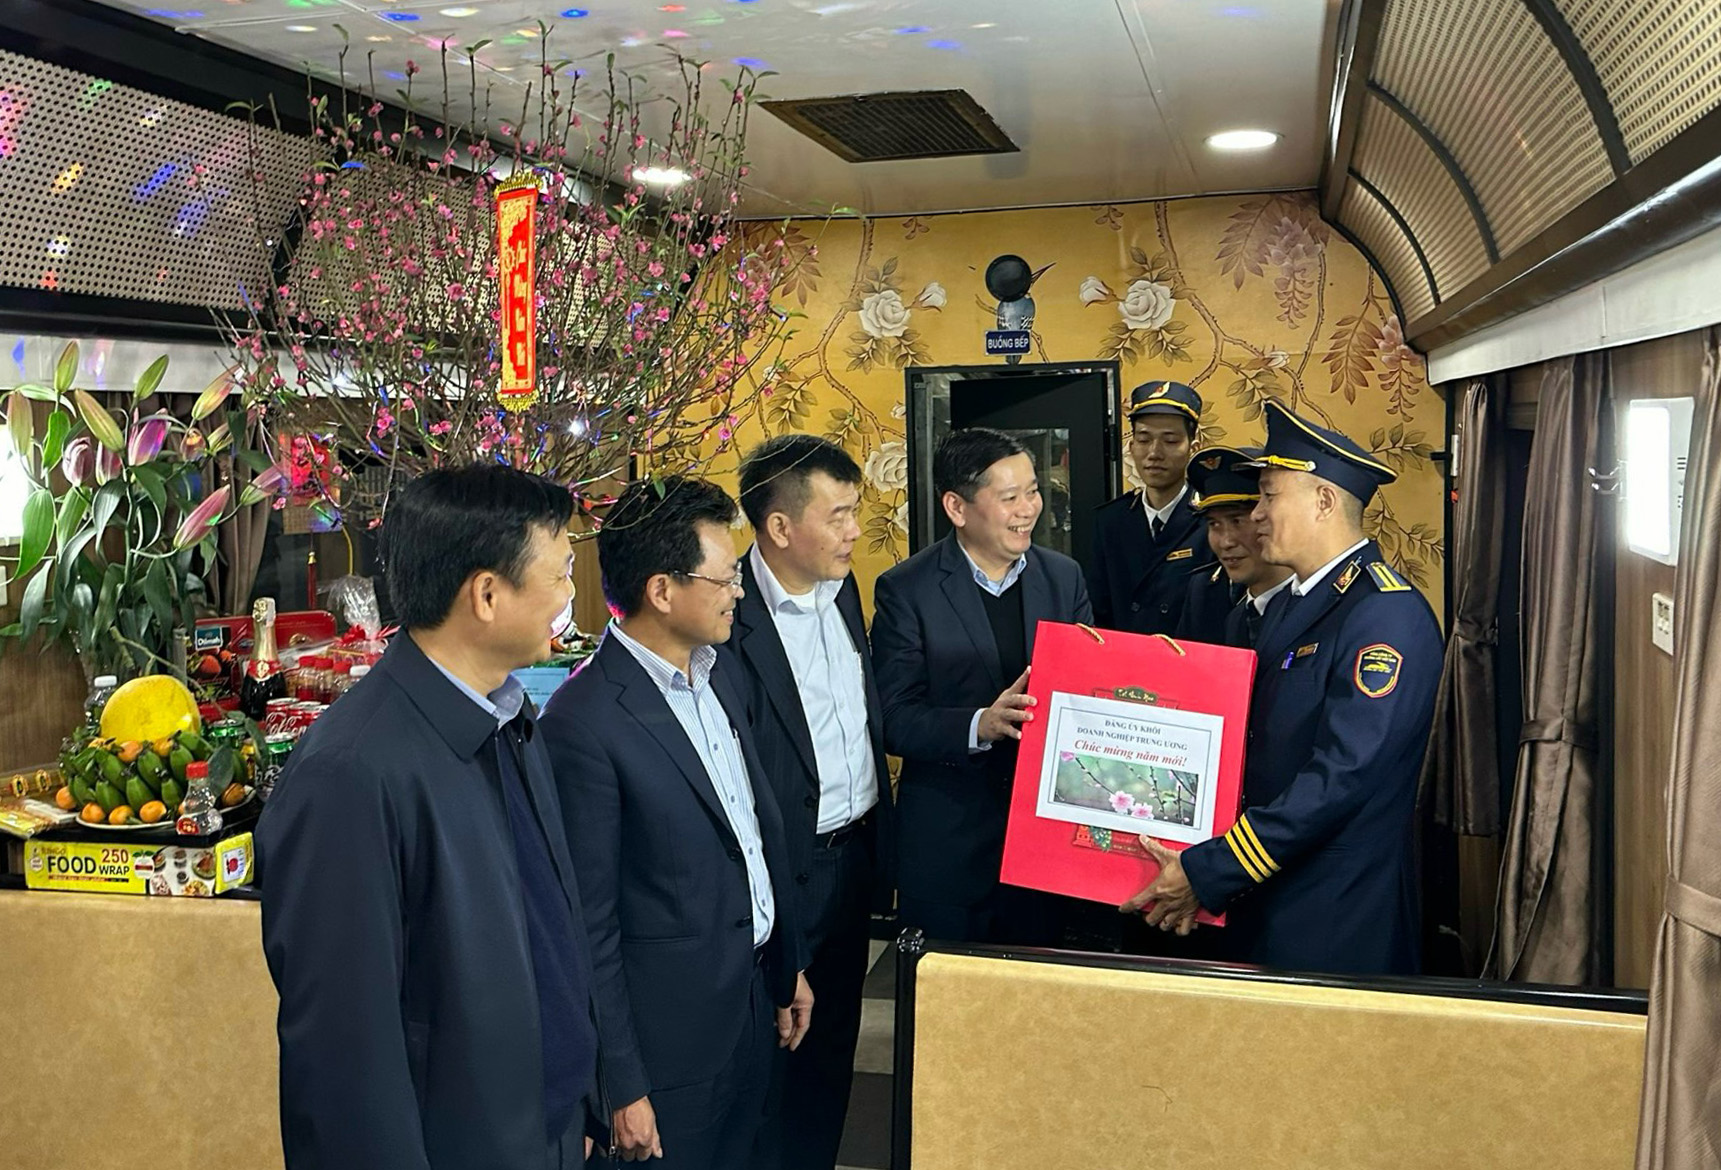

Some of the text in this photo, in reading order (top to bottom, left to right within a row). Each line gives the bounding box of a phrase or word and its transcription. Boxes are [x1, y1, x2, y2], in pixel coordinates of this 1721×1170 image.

[1014, 334, 1029, 348] BẾP
[1105, 719, 1127, 730] ĐẢNG
[1077, 727, 1105, 738] DOANH
[1106, 731, 1135, 743] NGHIỆP
[1136, 736, 1162, 747] TRUNG
[1074, 740, 1188, 767] Chúc mừng năm mới!
[101, 848, 130, 864] 250
[47, 856, 97, 875] FOOD
[98, 865, 130, 876] WRAP
